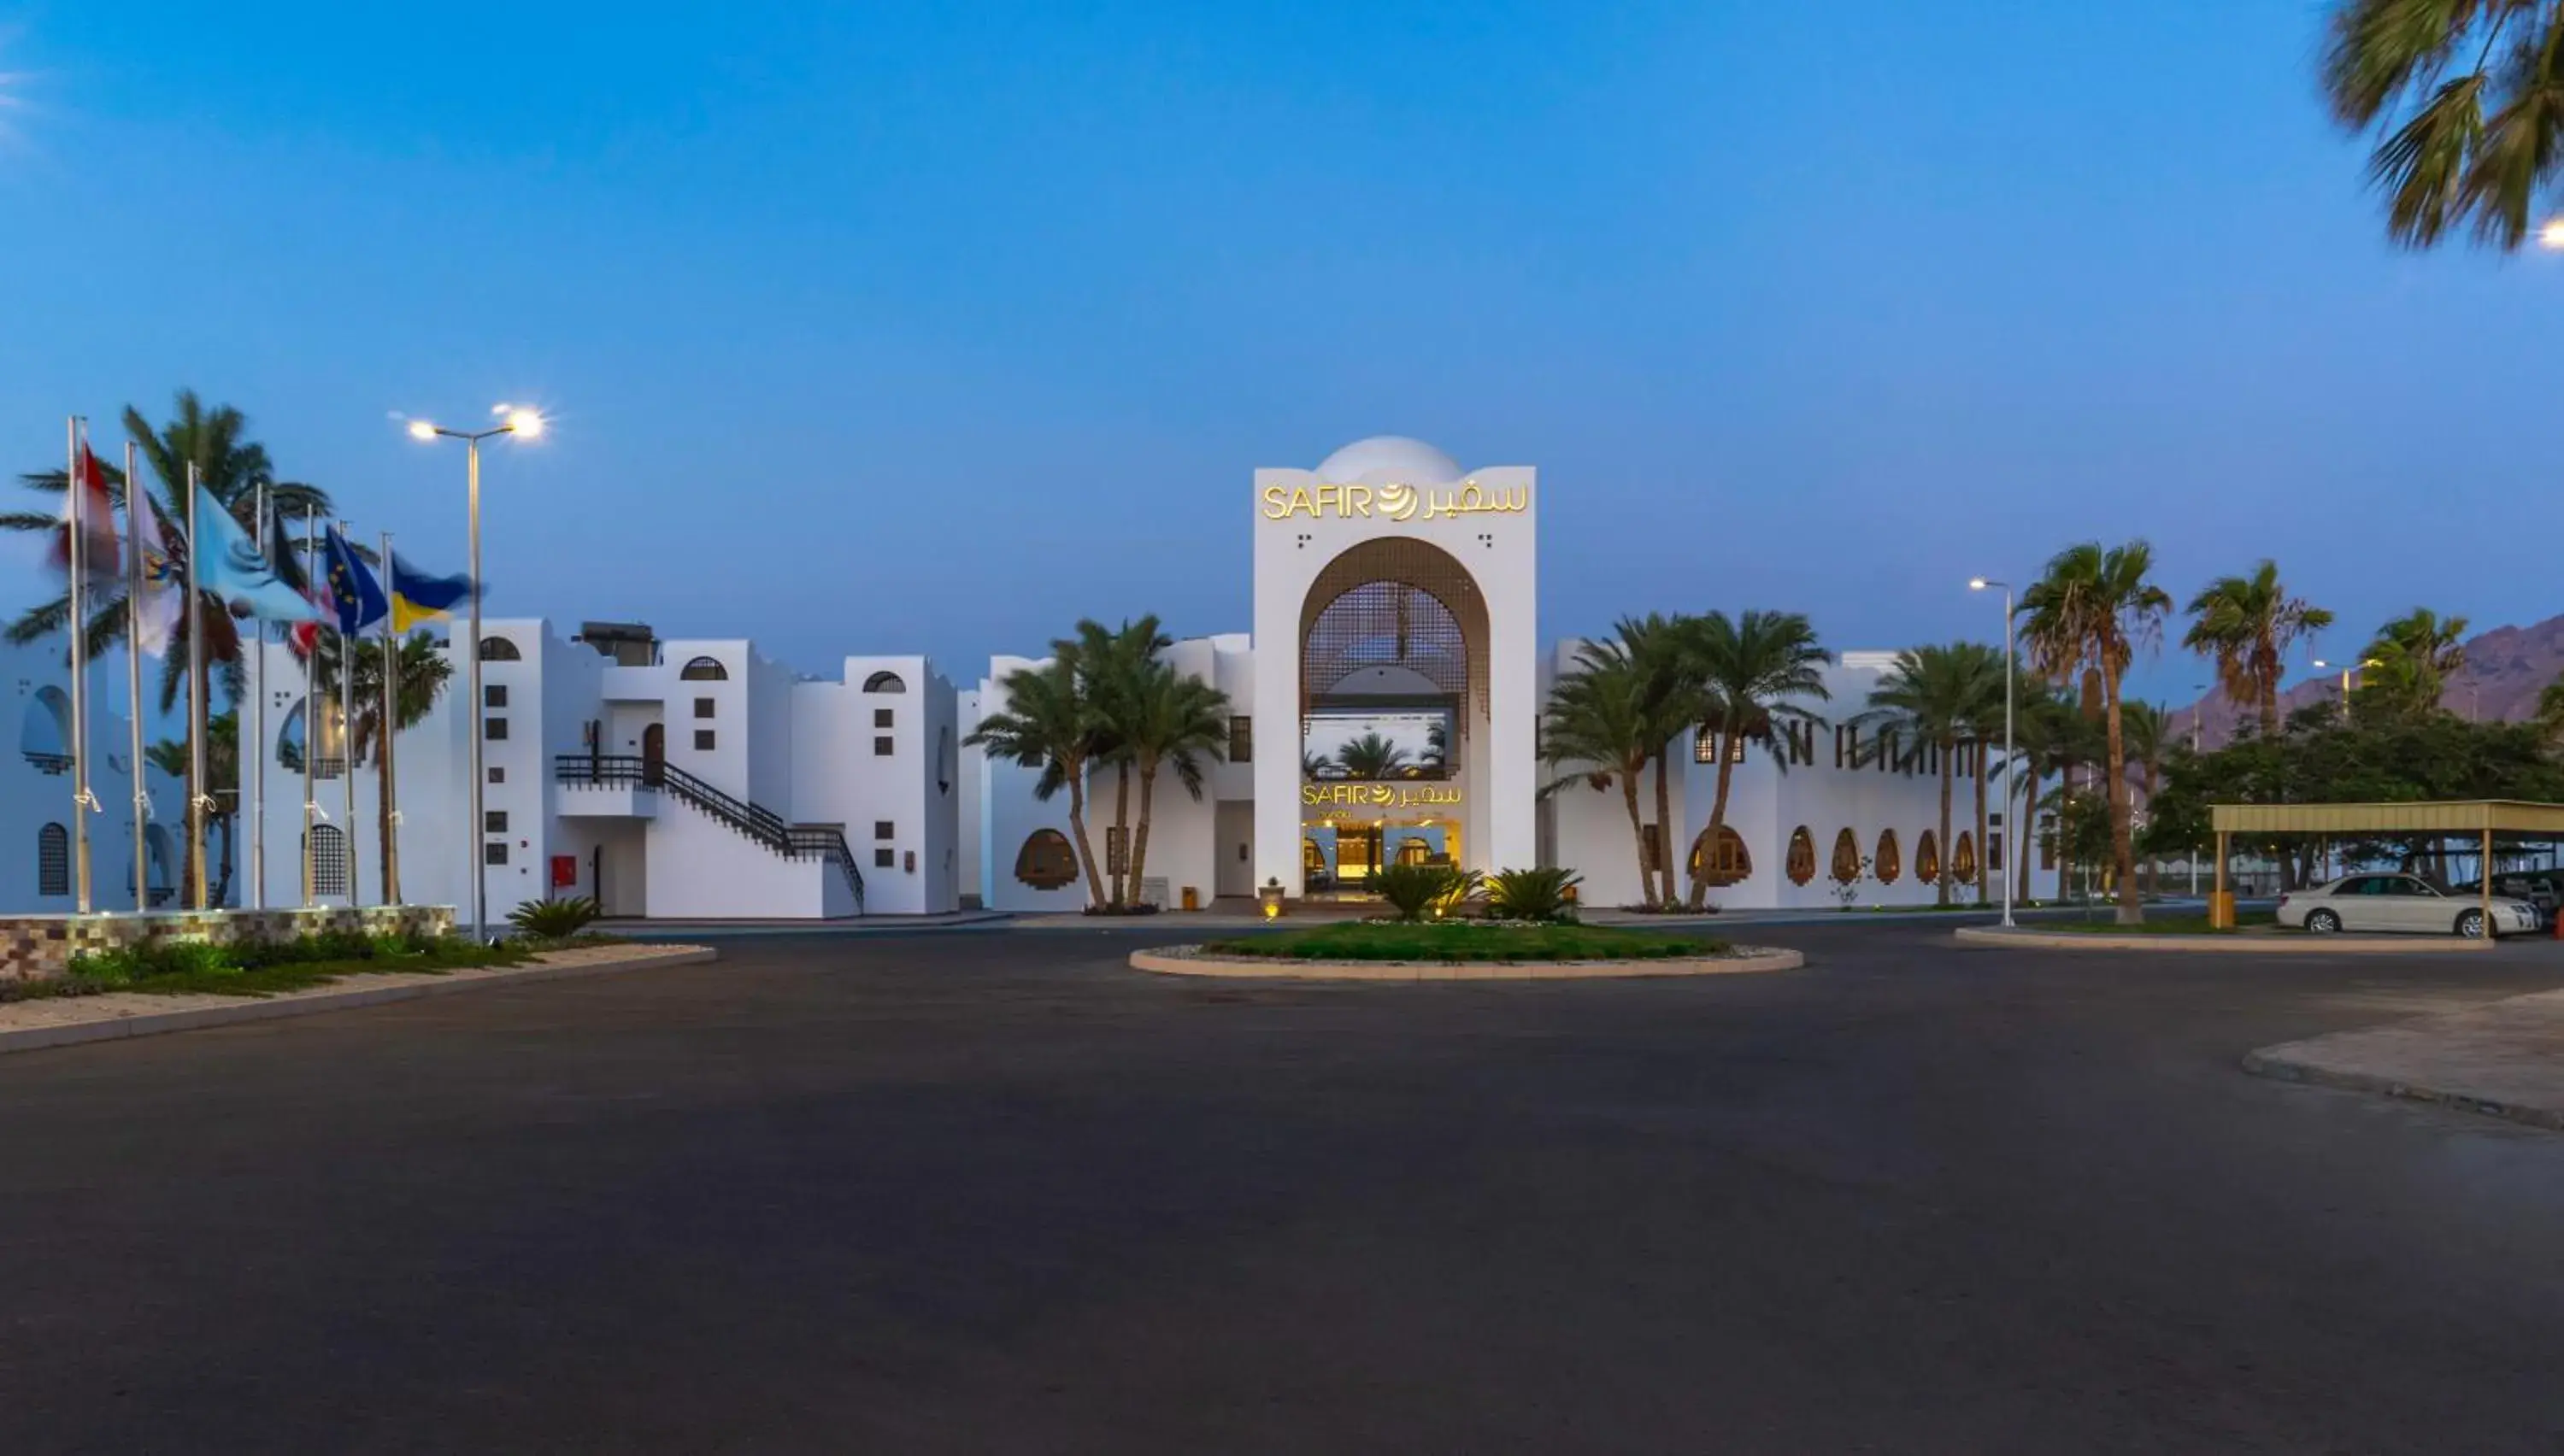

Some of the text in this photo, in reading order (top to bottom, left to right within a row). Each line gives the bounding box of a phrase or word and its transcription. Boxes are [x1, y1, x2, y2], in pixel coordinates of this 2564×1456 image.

[1262, 484, 1373, 520] SAFIR
[1422, 479, 1528, 520] سفير
[1302, 784, 1368, 805] SAFIR
[1399, 782, 1461, 807] سفير
